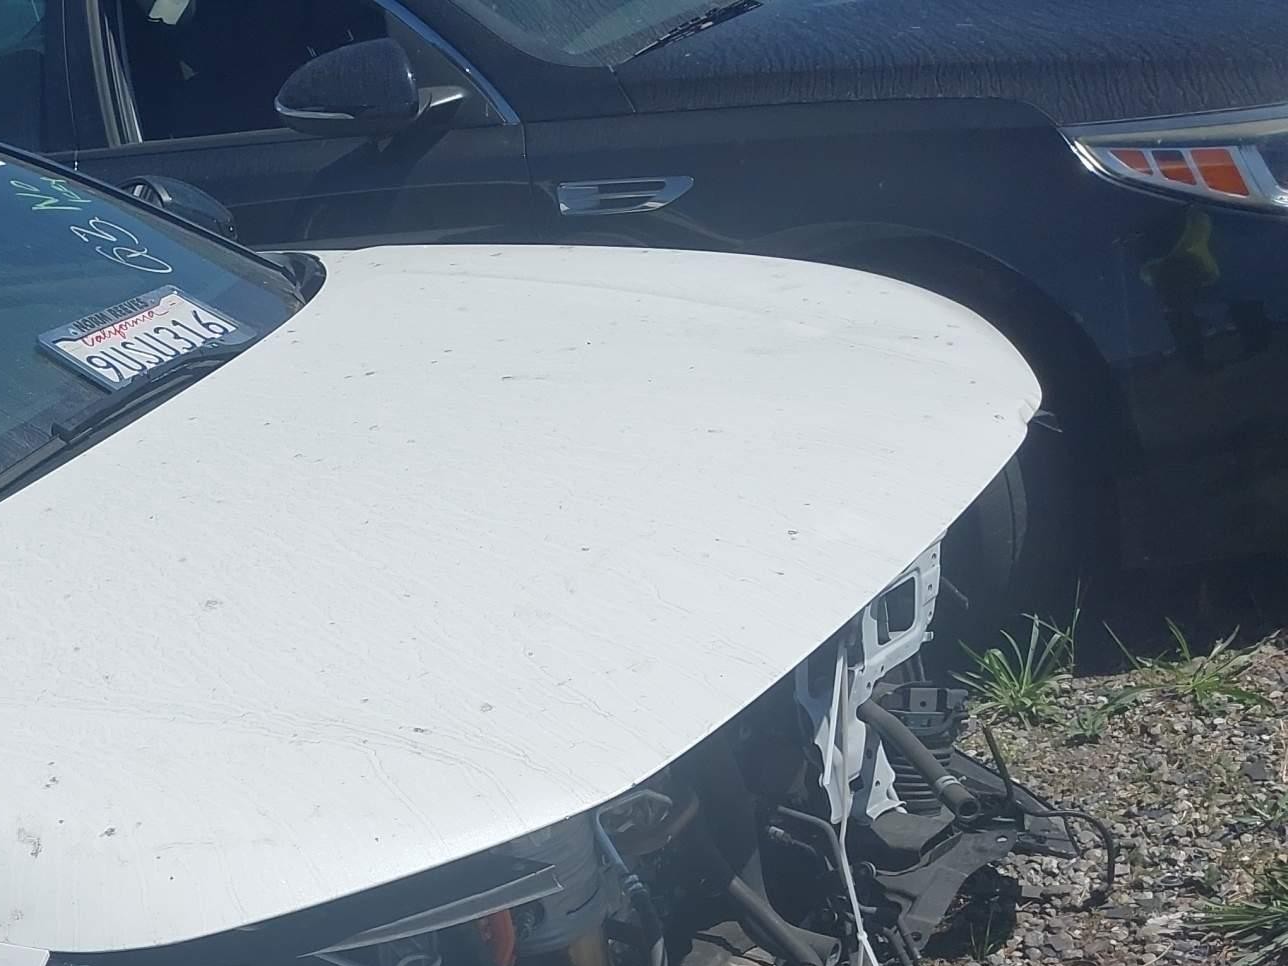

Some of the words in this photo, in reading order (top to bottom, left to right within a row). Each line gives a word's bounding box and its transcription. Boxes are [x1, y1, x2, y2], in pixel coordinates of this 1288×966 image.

[73, 309, 112, 333] NORM
[110, 297, 149, 319] REEVES
[81, 308, 169, 348] California
[85, 309, 231, 383] 9USU316
